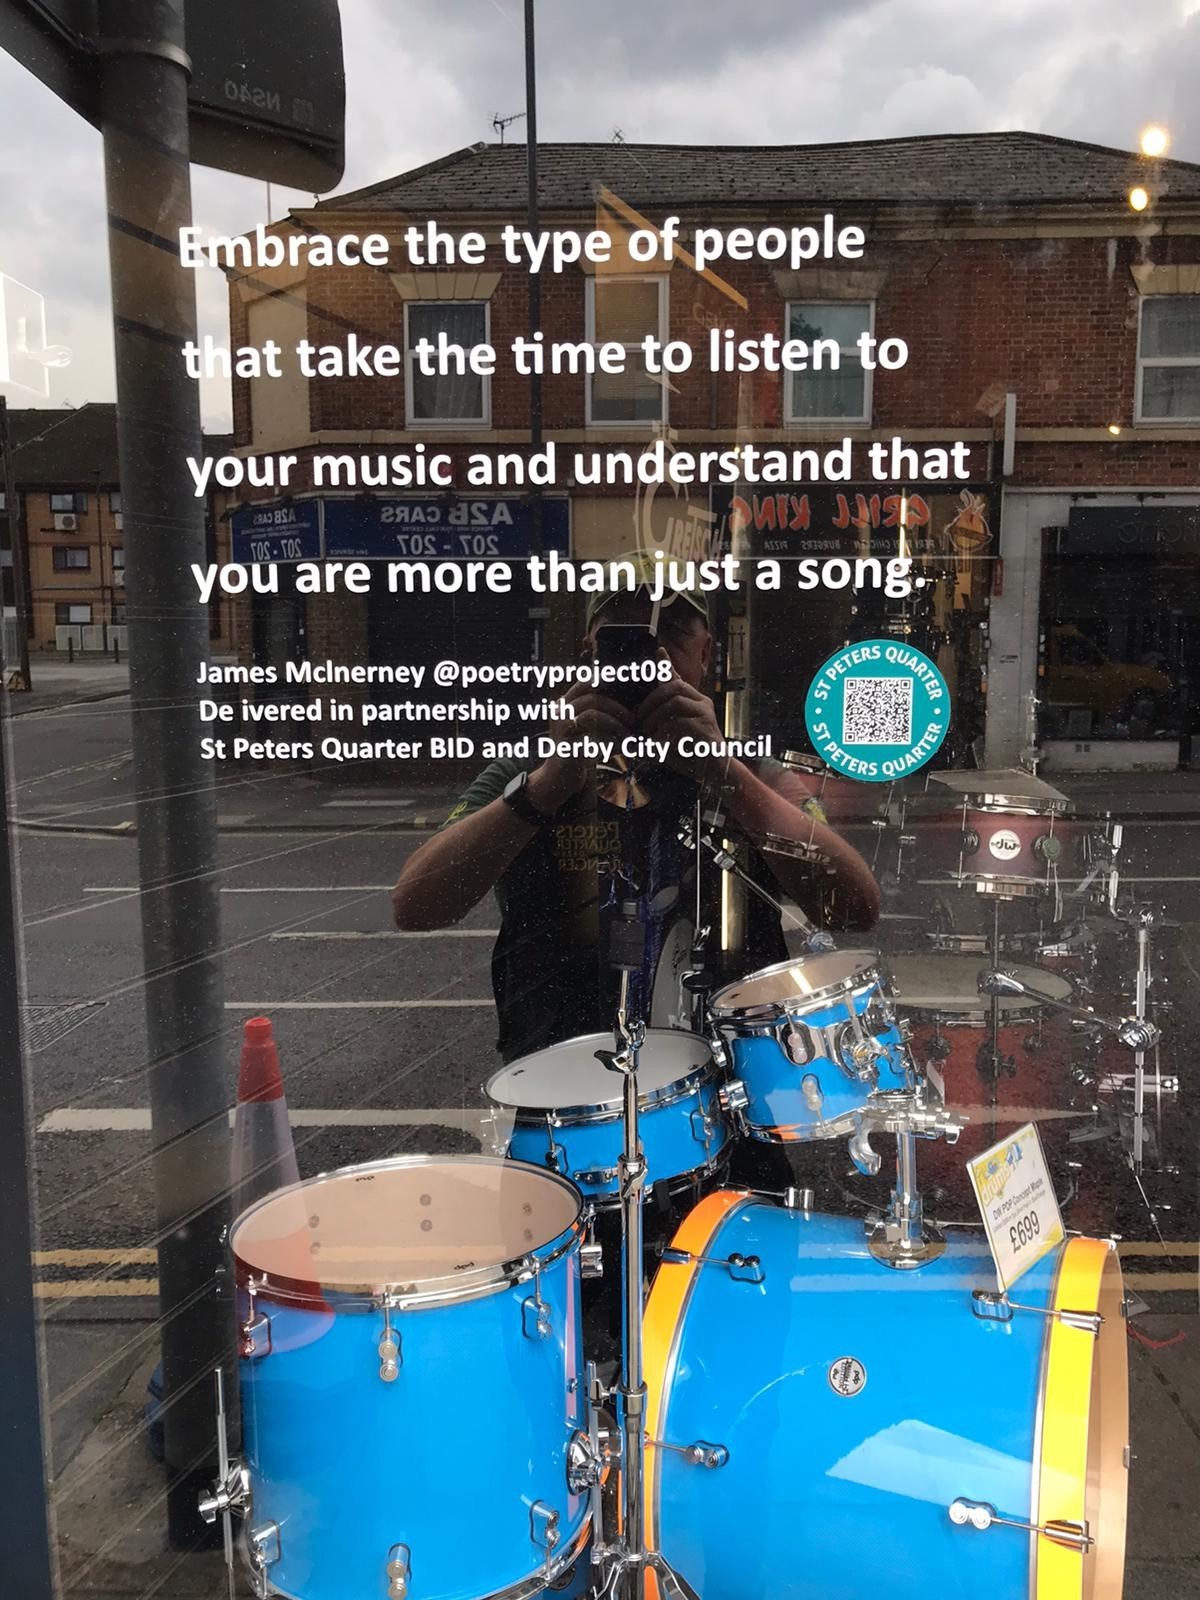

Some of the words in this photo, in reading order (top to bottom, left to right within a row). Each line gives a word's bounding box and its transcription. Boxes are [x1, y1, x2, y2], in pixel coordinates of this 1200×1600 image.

[178, 223, 390, 270] Embrace
[404, 220, 486, 265] the
[501, 225, 612, 274] type
[628, 216, 680, 262] of
[695, 214, 865, 271] people
[181, 336, 282, 379] that
[295, 333, 401, 377] take
[415, 332, 496, 376] the
[511, 331, 626, 375] time
[641, 335, 692, 373] to
[707, 328, 840, 372] listen
[856, 331, 908, 370] to
[187, 452, 297, 497] your
[313, 443, 452, 486] music
[467, 441, 556, 485] and
[574, 437, 852, 485] understand
[868, 439, 971, 480] that
[191, 562, 278, 605] you
[295, 562, 371, 594] are
[388, 561, 512, 594] more
[526, 550, 636, 594] than
[650, 550, 740, 603] just
[755, 559, 781, 590] a
[798, 554, 926, 599] song.
[196, 661, 278, 684] James
[285, 659, 426, 688] McInerney
[433, 659, 672, 688] @poetryproject08
[814, 678, 831, 701] ST
[825, 645, 881, 681] PETERS
[885, 646, 943, 701] QUARTER
[330, 698, 353, 721] in
[362, 698, 510, 726] partnership
[517, 697, 577, 721] with
[200, 738, 226, 760] St
[233, 738, 314, 760] Peters
[321, 737, 423, 763] Quarter
[430, 737, 474, 759] BID
[482, 736, 529, 759] and
[538, 735, 614, 764] Derby
[621, 735, 670, 763] City
[677, 733, 772, 758] Council
[813, 722, 831, 742] ST
[824, 742, 877, 776] PETERS
[882, 722, 943, 777] QUARTER
[1009, 1210, 1041, 1254] £699
